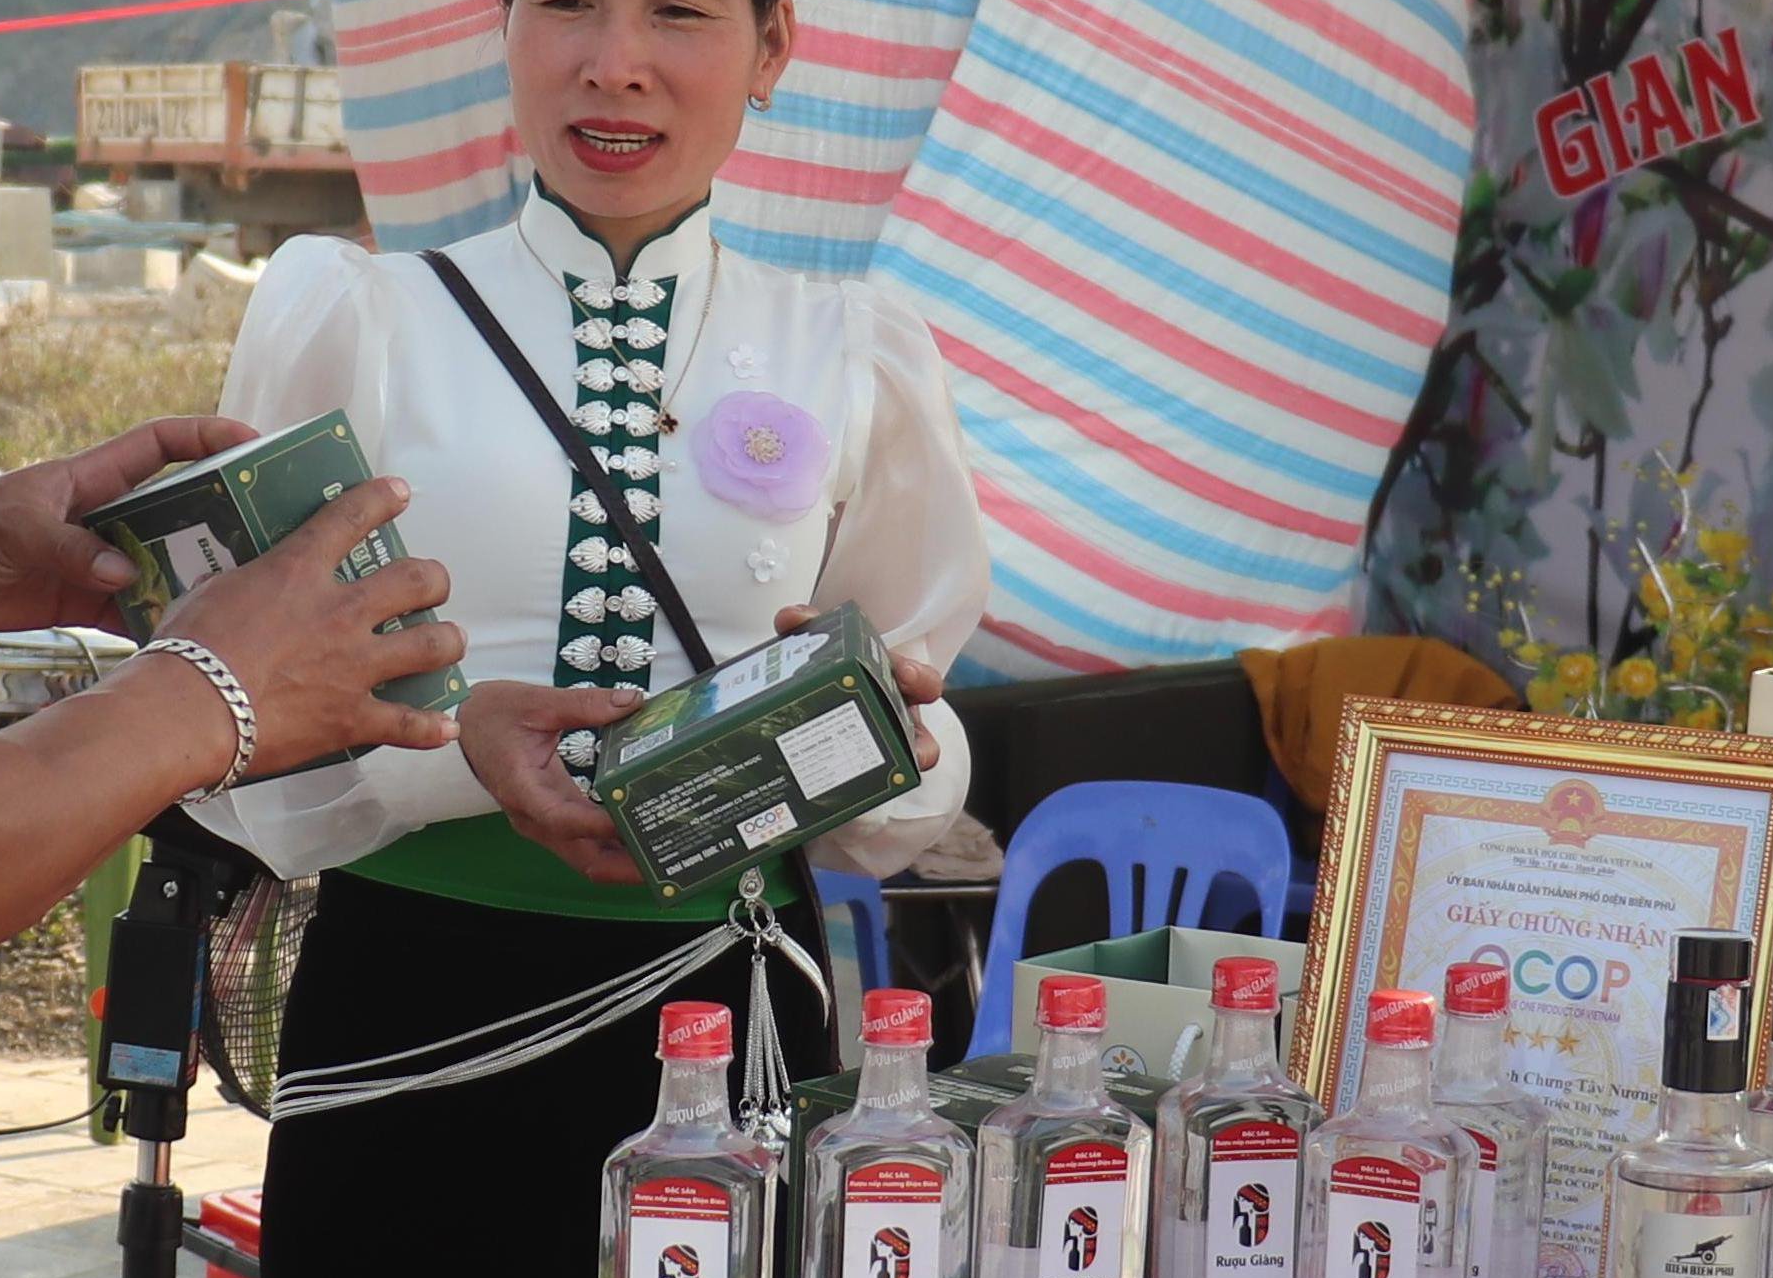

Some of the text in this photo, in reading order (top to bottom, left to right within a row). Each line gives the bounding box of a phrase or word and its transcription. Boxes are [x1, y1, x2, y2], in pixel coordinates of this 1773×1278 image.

[1532, 34, 1759, 198] GIAN
[1446, 901, 1503, 927] GIẤY
[1598, 921, 1666, 950] NHẬN
[1250, 1253, 1284, 1267] Giàng
